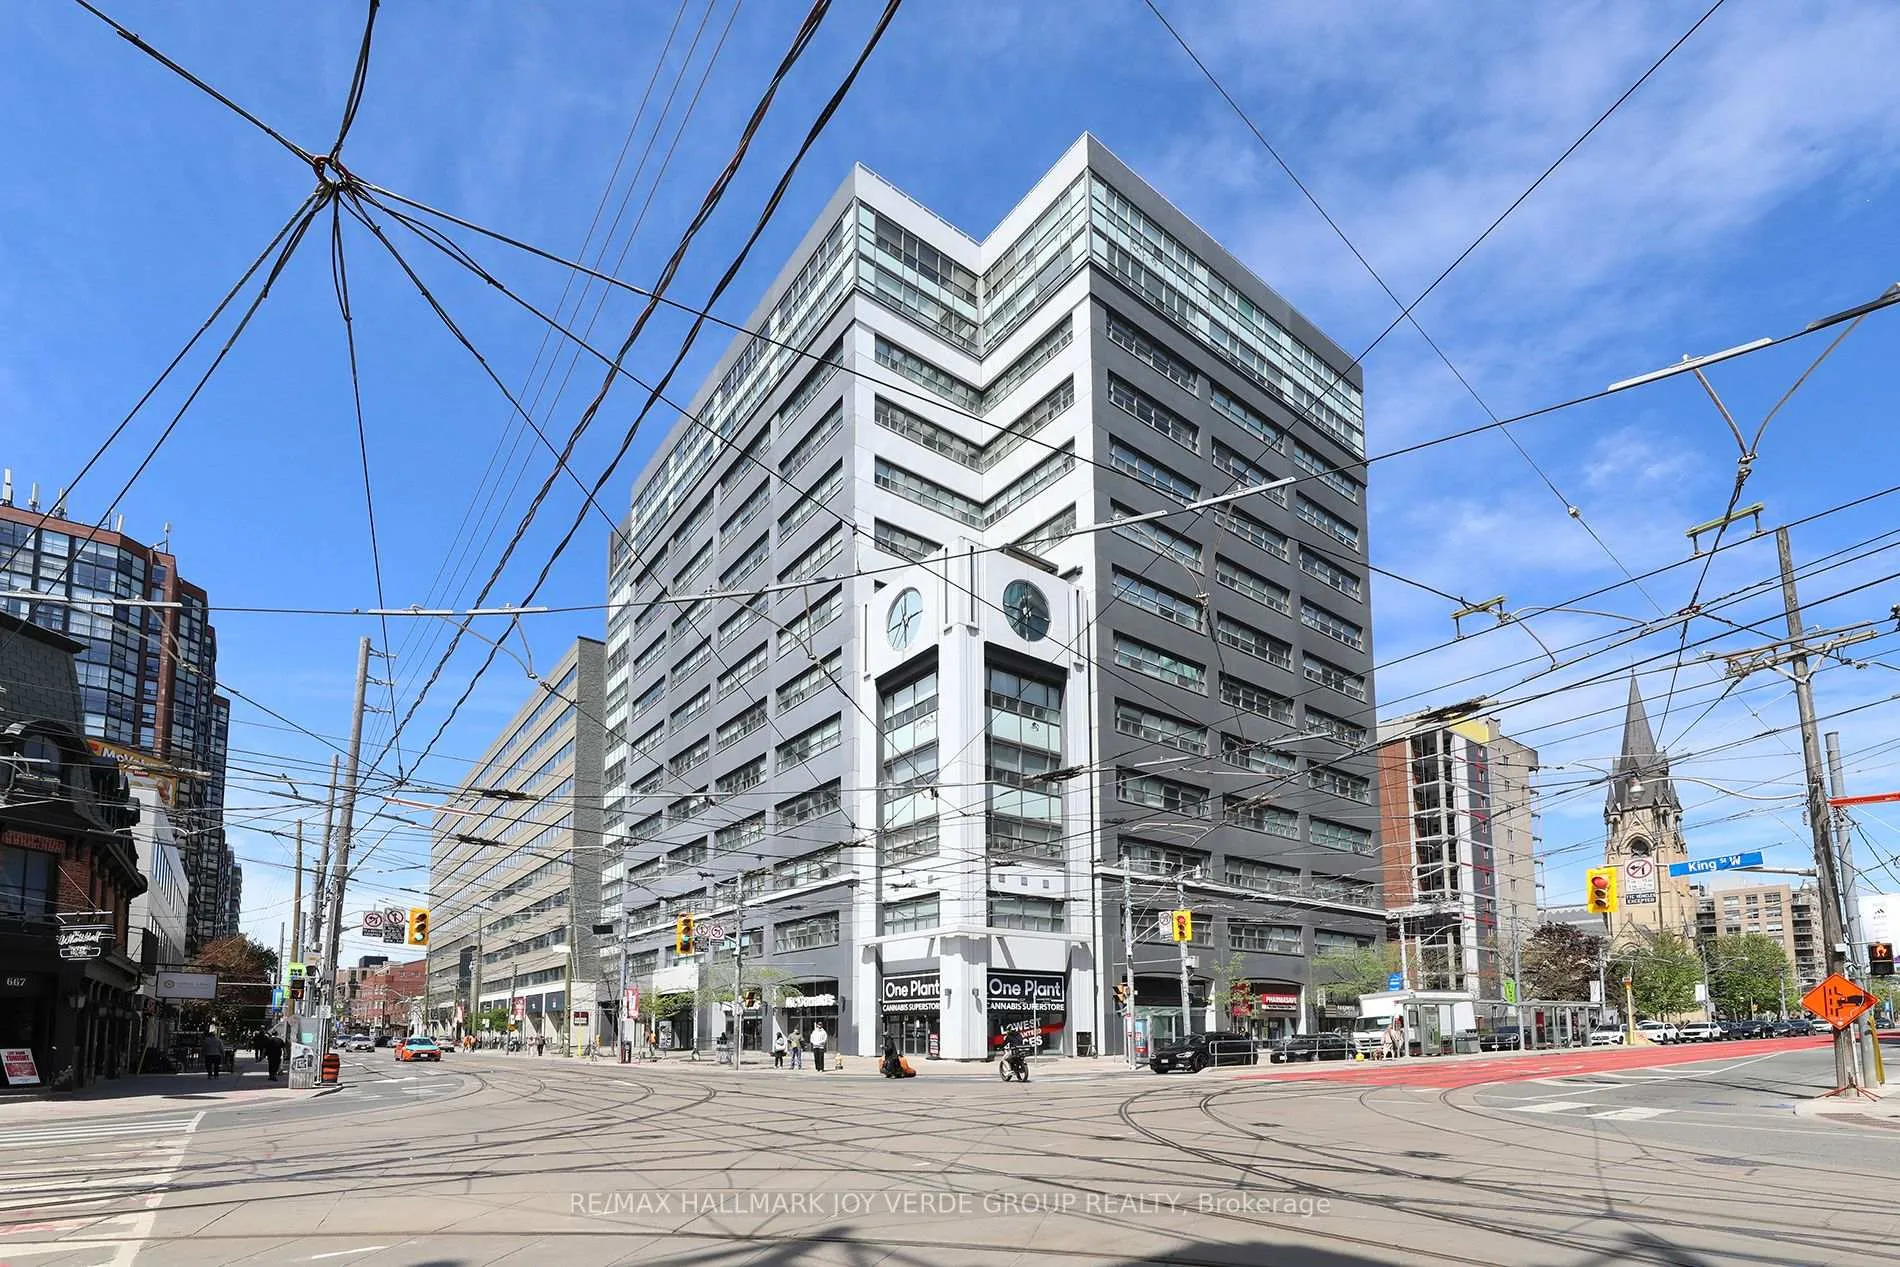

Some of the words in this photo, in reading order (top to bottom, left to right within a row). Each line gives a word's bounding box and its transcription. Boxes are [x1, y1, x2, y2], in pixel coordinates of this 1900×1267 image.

[1688, 860, 1717, 873] King
[1729, 855, 1741, 867] W
[6, 977, 26, 986] 667
[886, 982, 909, 998] One
[910, 979, 940, 996] Plant
[989, 978, 1021, 995] One
[1025, 980, 1061, 996] Plant
[883, 1003, 909, 1012] CANNABIS
[909, 1002, 940, 1011] SUPERSTOR
[1023, 1003, 1064, 1011] SUPERSTORE
